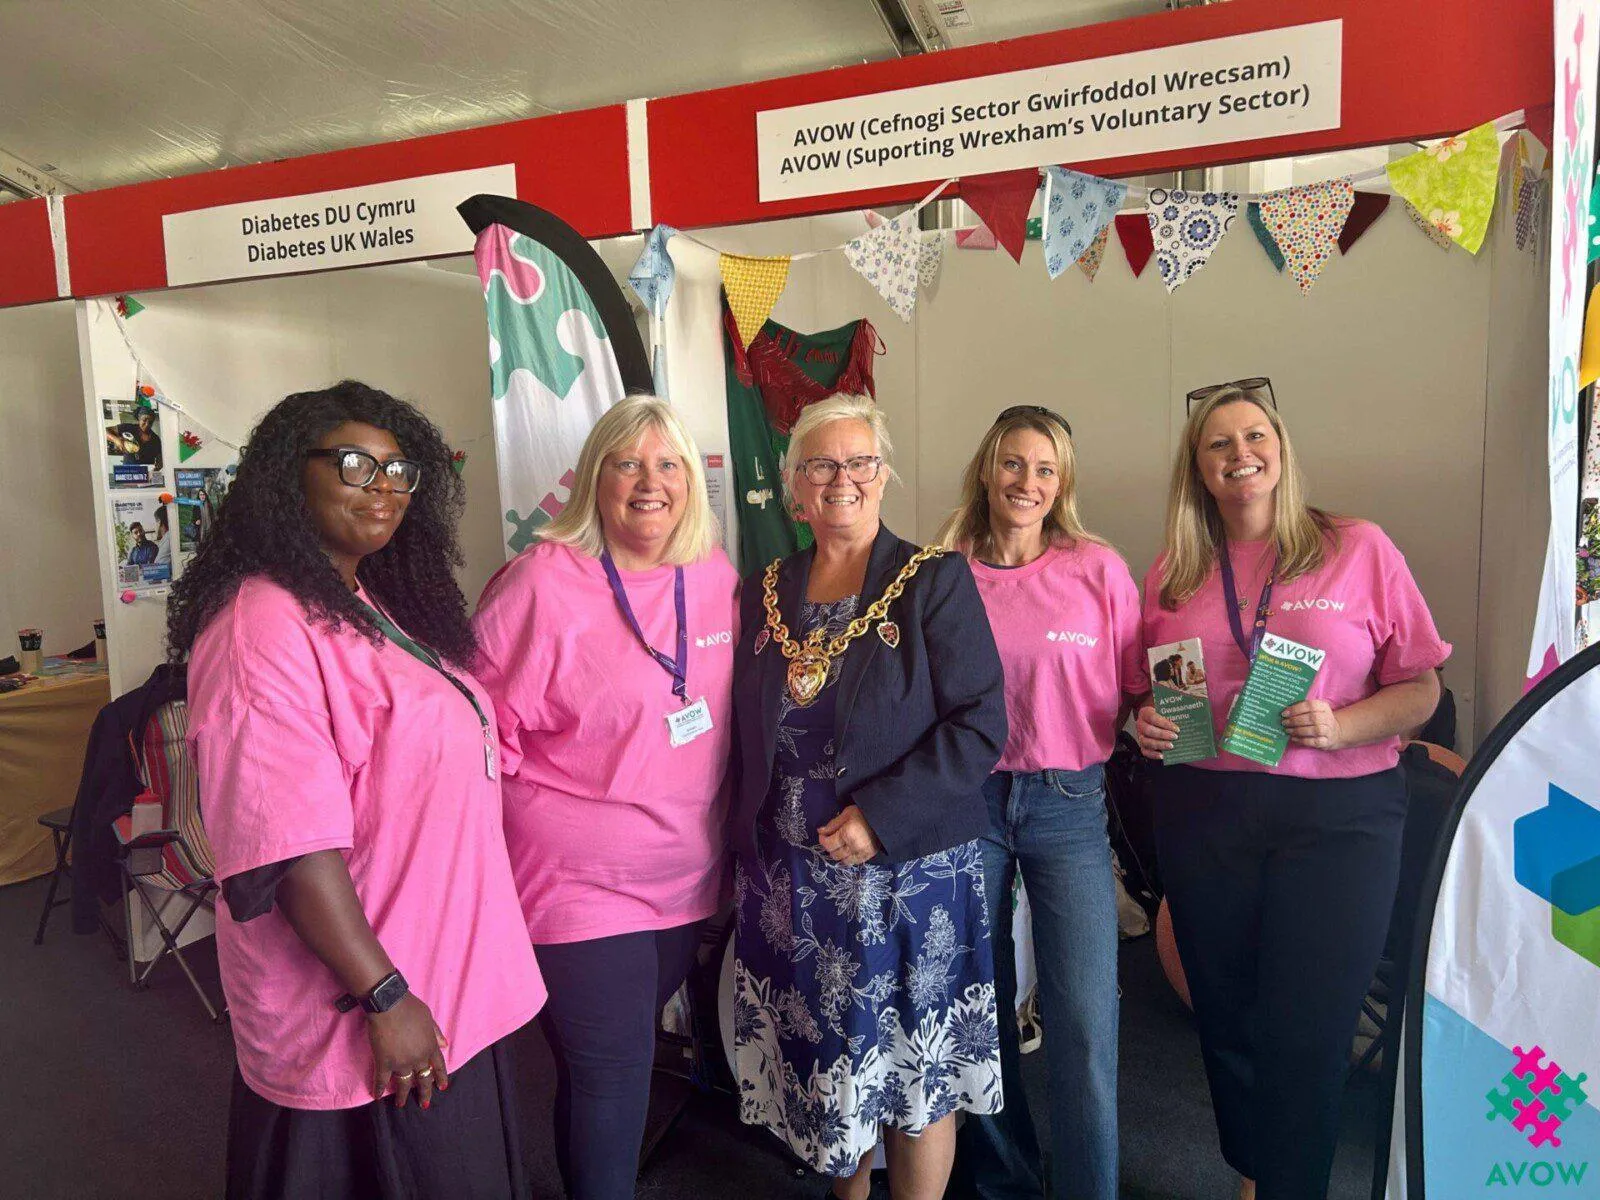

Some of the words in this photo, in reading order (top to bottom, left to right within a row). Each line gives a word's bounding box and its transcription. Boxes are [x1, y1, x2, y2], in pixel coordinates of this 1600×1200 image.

[793, 121, 855, 147] AVOW
[860, 107, 945, 140] (Cefnogi
[951, 99, 1021, 124] Sector
[1027, 75, 1157, 113] Gwirfoddol
[1163, 55, 1291, 93] Wrecsam)
[780, 150, 841, 175] AVOW
[846, 137, 955, 169] (Suporting
[959, 117, 1084, 150] Wrexham’s
[1091, 101, 1212, 132] Voluntary
[1219, 83, 1311, 115] Sector)
[242, 213, 320, 236] Diabetes
[325, 204, 351, 226] DU
[356, 198, 415, 225] Cymru
[247, 239, 326, 262] Diabetes
[330, 232, 356, 253] UK
[359, 226, 414, 250] Wales
[1292, 598, 1345, 612] AVOW
[706, 630, 734, 646] AVO
[1058, 630, 1100, 648] AVOW
[1274, 642, 1323, 665] AVOW
[1160, 695, 1183, 705] AVOW
[681, 707, 702, 721] AVOW
